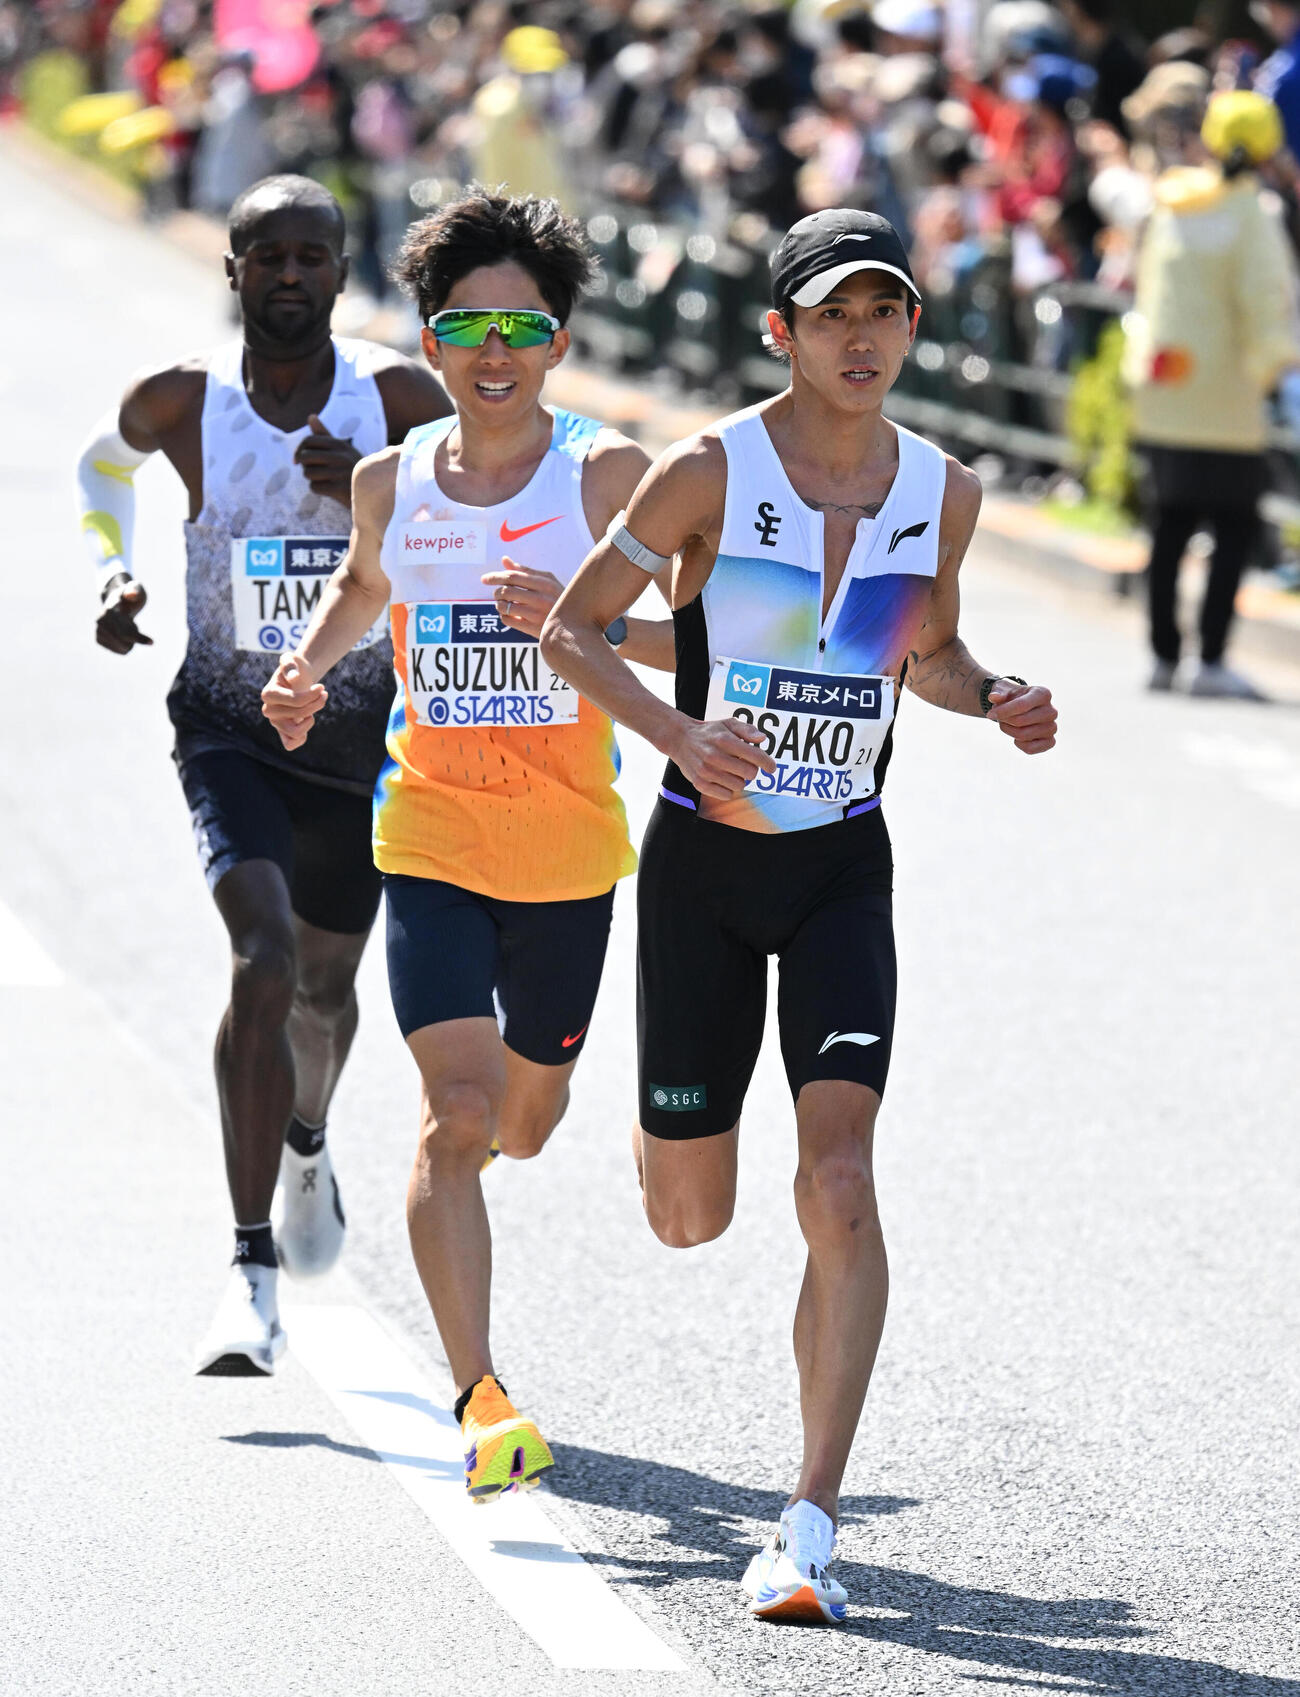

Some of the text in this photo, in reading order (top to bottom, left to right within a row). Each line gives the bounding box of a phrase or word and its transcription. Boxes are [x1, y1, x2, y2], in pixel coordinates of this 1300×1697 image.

[405, 532, 464, 553] kewpie
[253, 580, 329, 620] TAM
[458, 614, 511, 632] 東京
[412, 647, 538, 692] K.SUZUKI
[776, 681, 875, 708] 東京メトロ
[855, 747, 872, 765] 21
[672, 1092, 700, 1106] SGC
